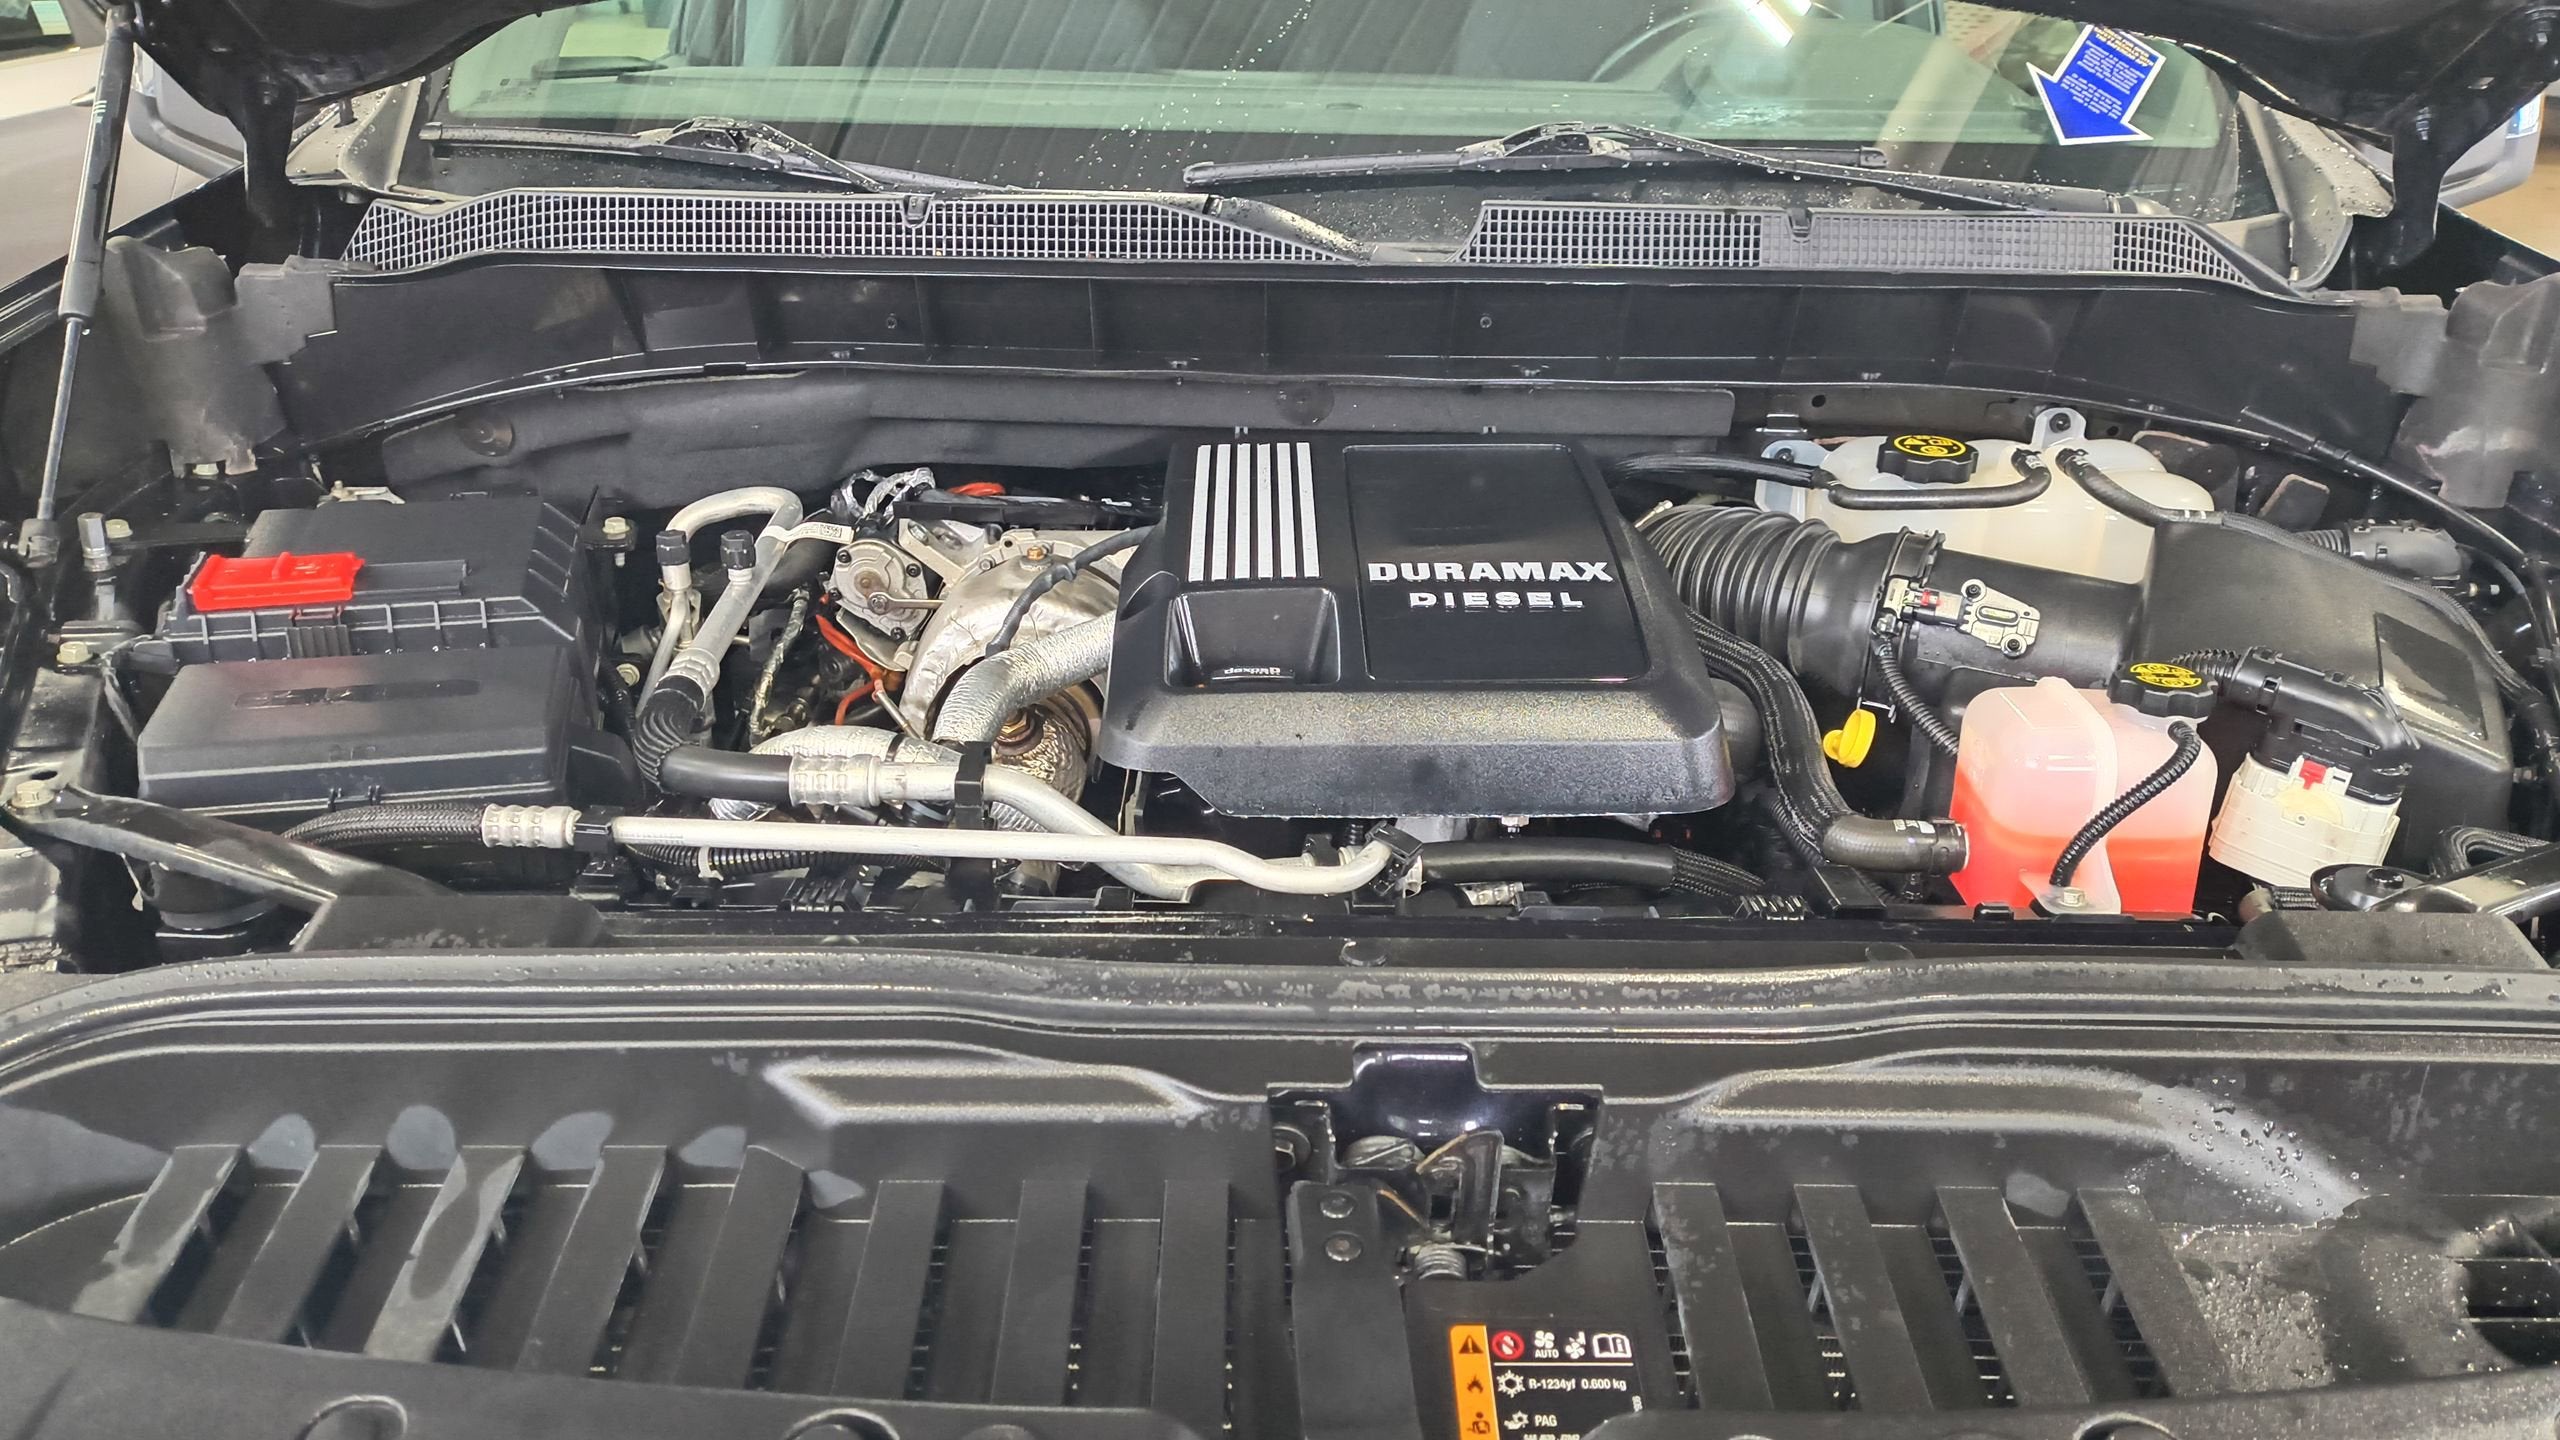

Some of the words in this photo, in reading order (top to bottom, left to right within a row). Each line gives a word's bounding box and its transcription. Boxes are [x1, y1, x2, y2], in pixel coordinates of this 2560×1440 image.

[1367, 561, 1613, 582] DURAMAX
[1409, 592, 1584, 609] DIESEL
[1535, 1349, 1559, 1359] AUTO
[1528, 1377, 1576, 1392] R-1234yf
[1581, 1378, 1611, 1390] 0.600
[1613, 1378, 1627, 1391] kg
[1535, 1414, 1558, 1427] PAG
